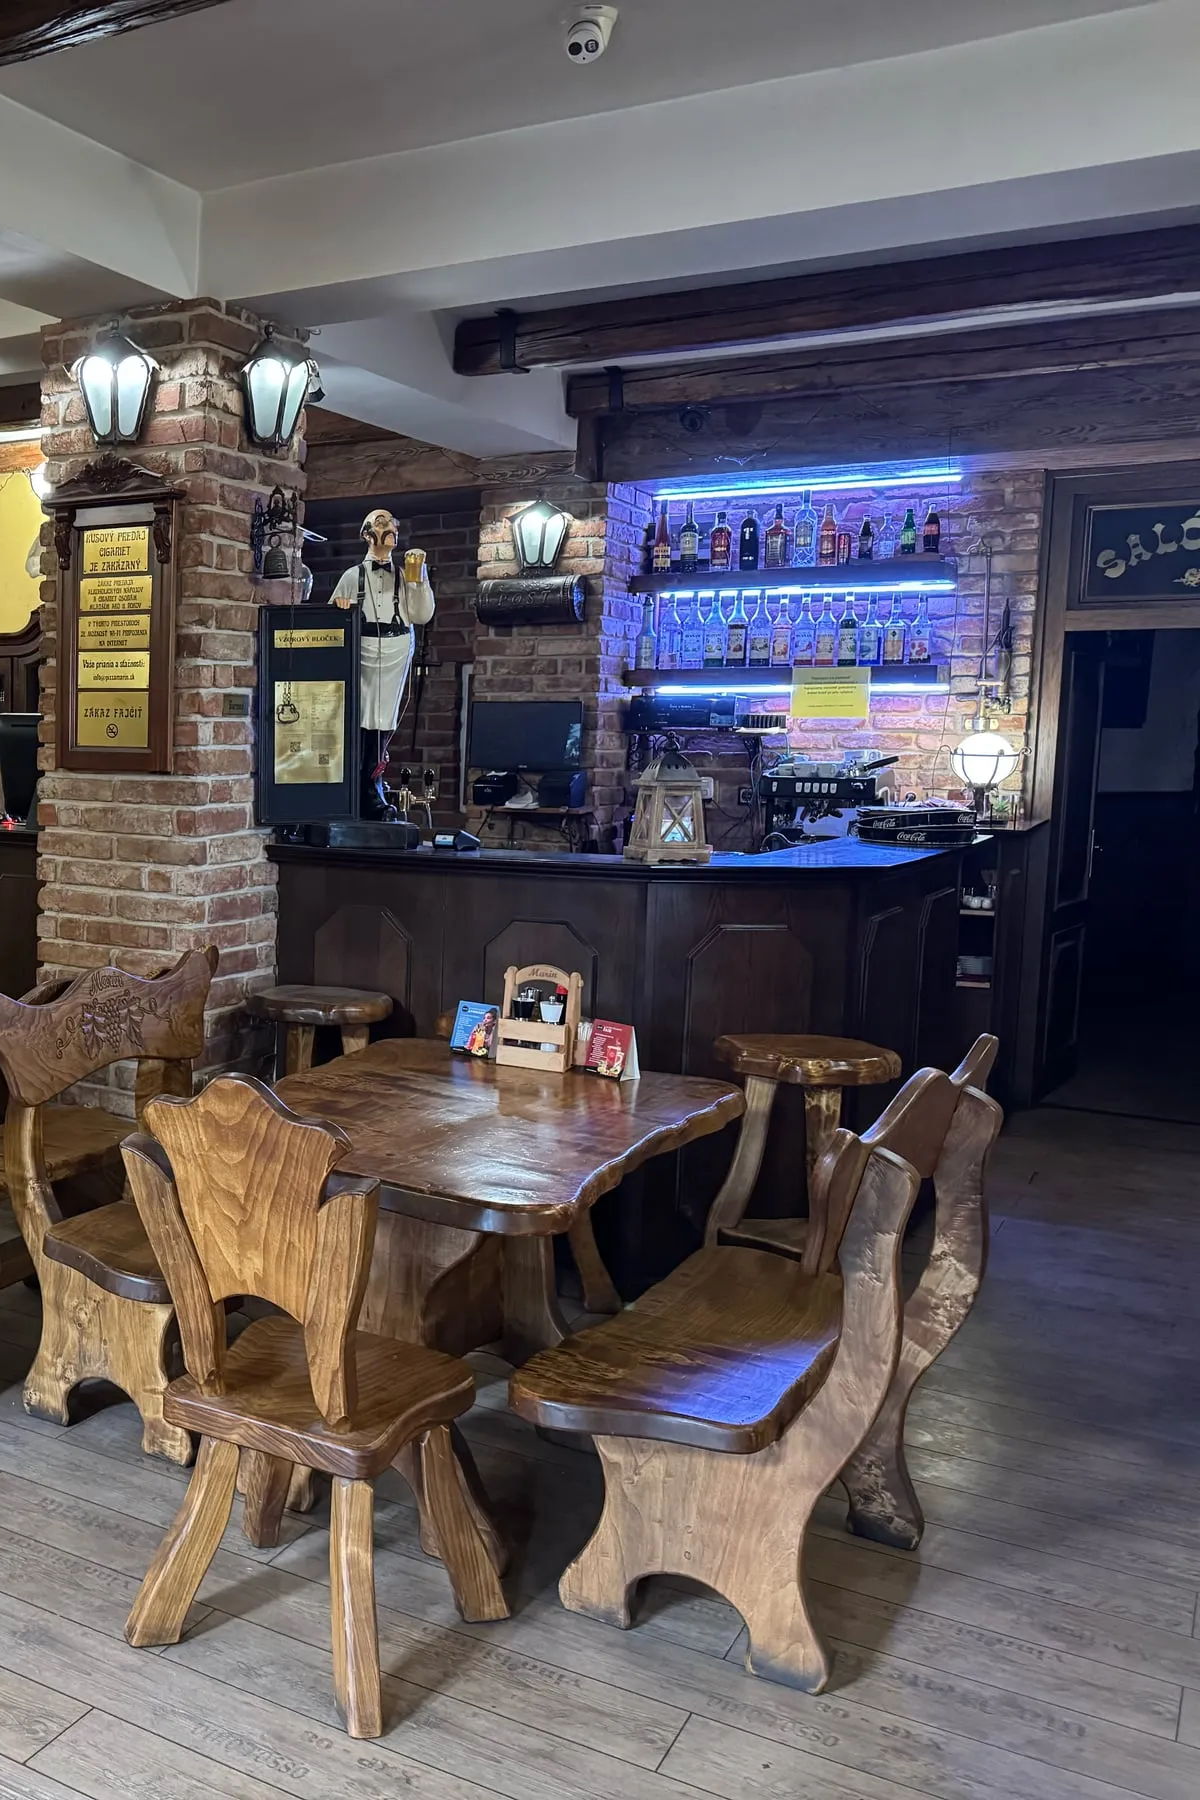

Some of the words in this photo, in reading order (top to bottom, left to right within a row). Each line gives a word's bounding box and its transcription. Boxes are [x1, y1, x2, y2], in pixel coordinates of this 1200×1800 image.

[89, 562, 99, 572] JE
[83, 706, 111, 718] ZÁKAZ
[113, 706, 143, 718] FAJČIŤ
